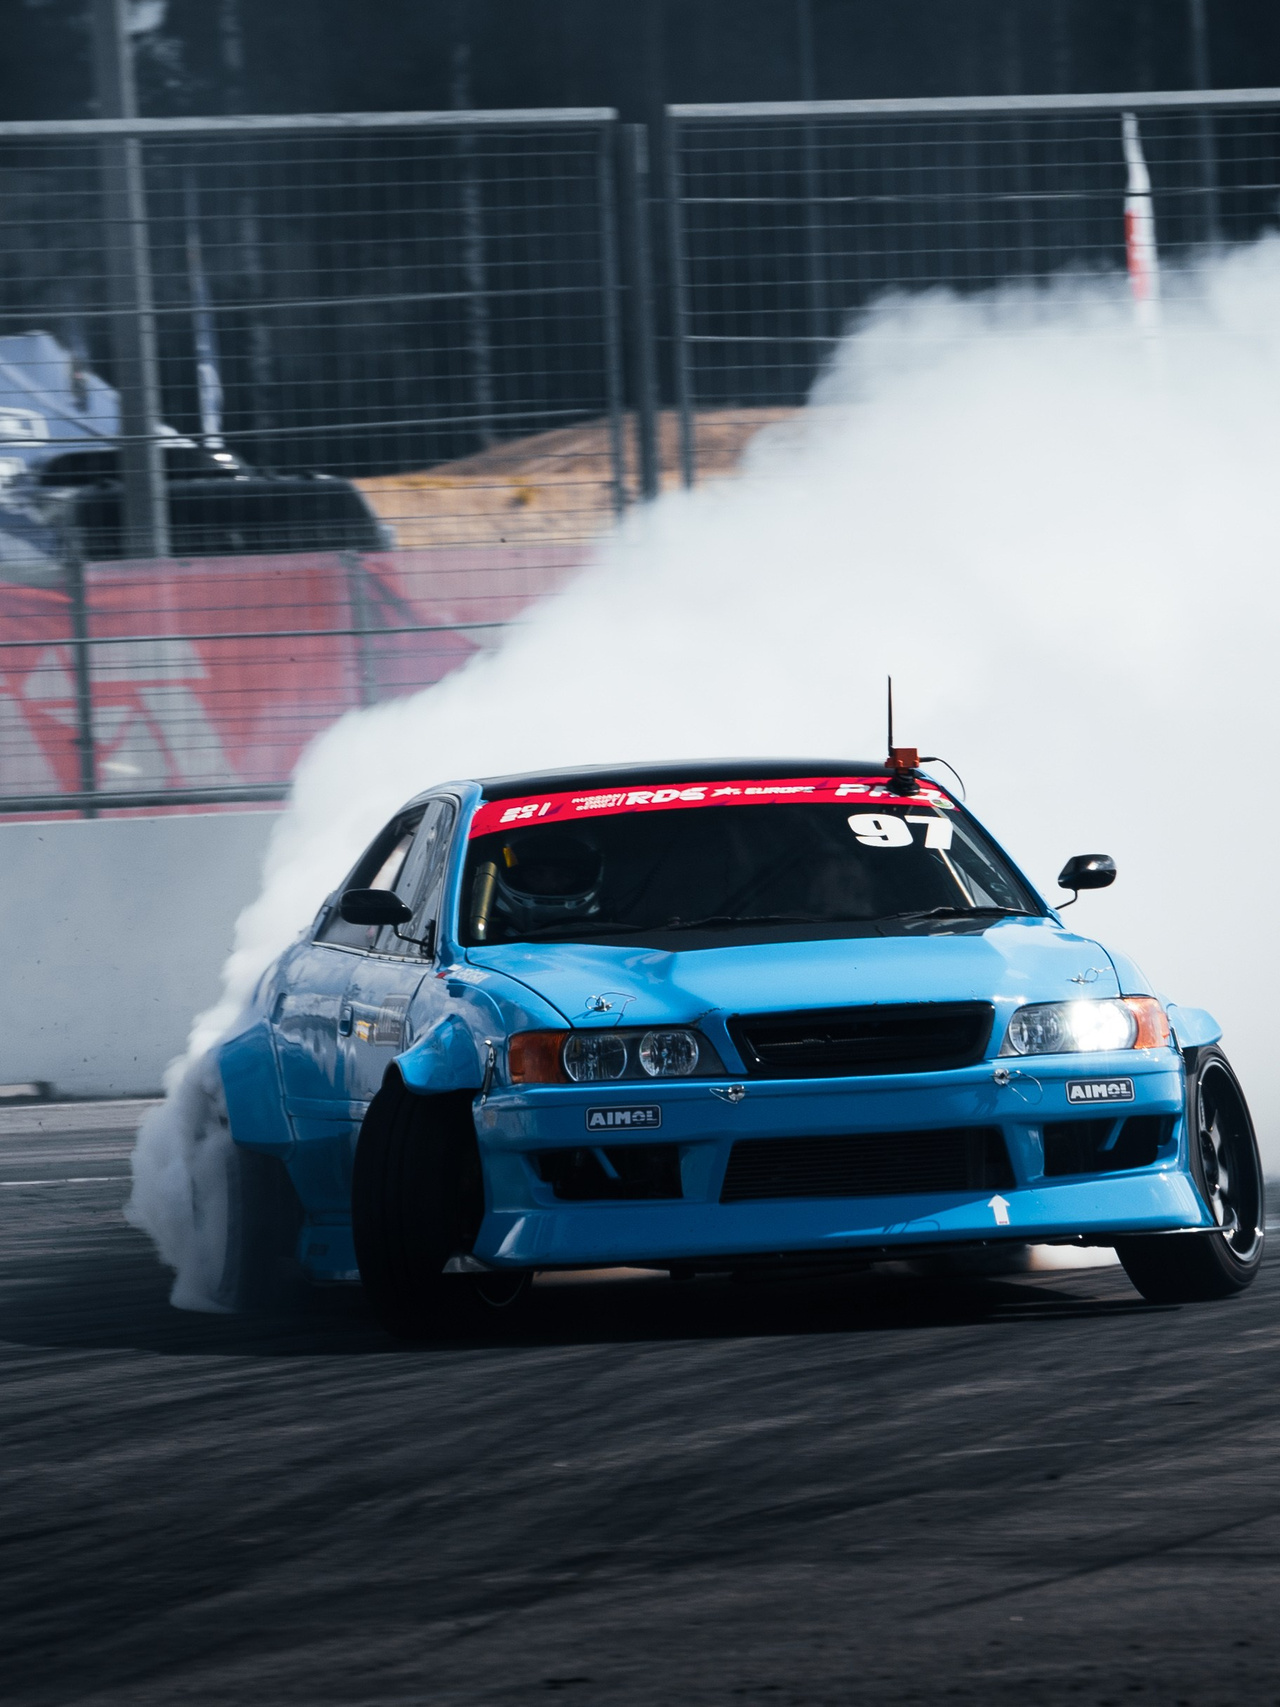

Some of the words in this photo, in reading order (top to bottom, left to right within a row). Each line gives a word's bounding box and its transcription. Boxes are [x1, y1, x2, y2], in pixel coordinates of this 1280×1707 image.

[847, 813, 954, 850] 97
[1070, 1083, 1132, 1100] AIMOL
[589, 1110, 658, 1127] AIMOL
